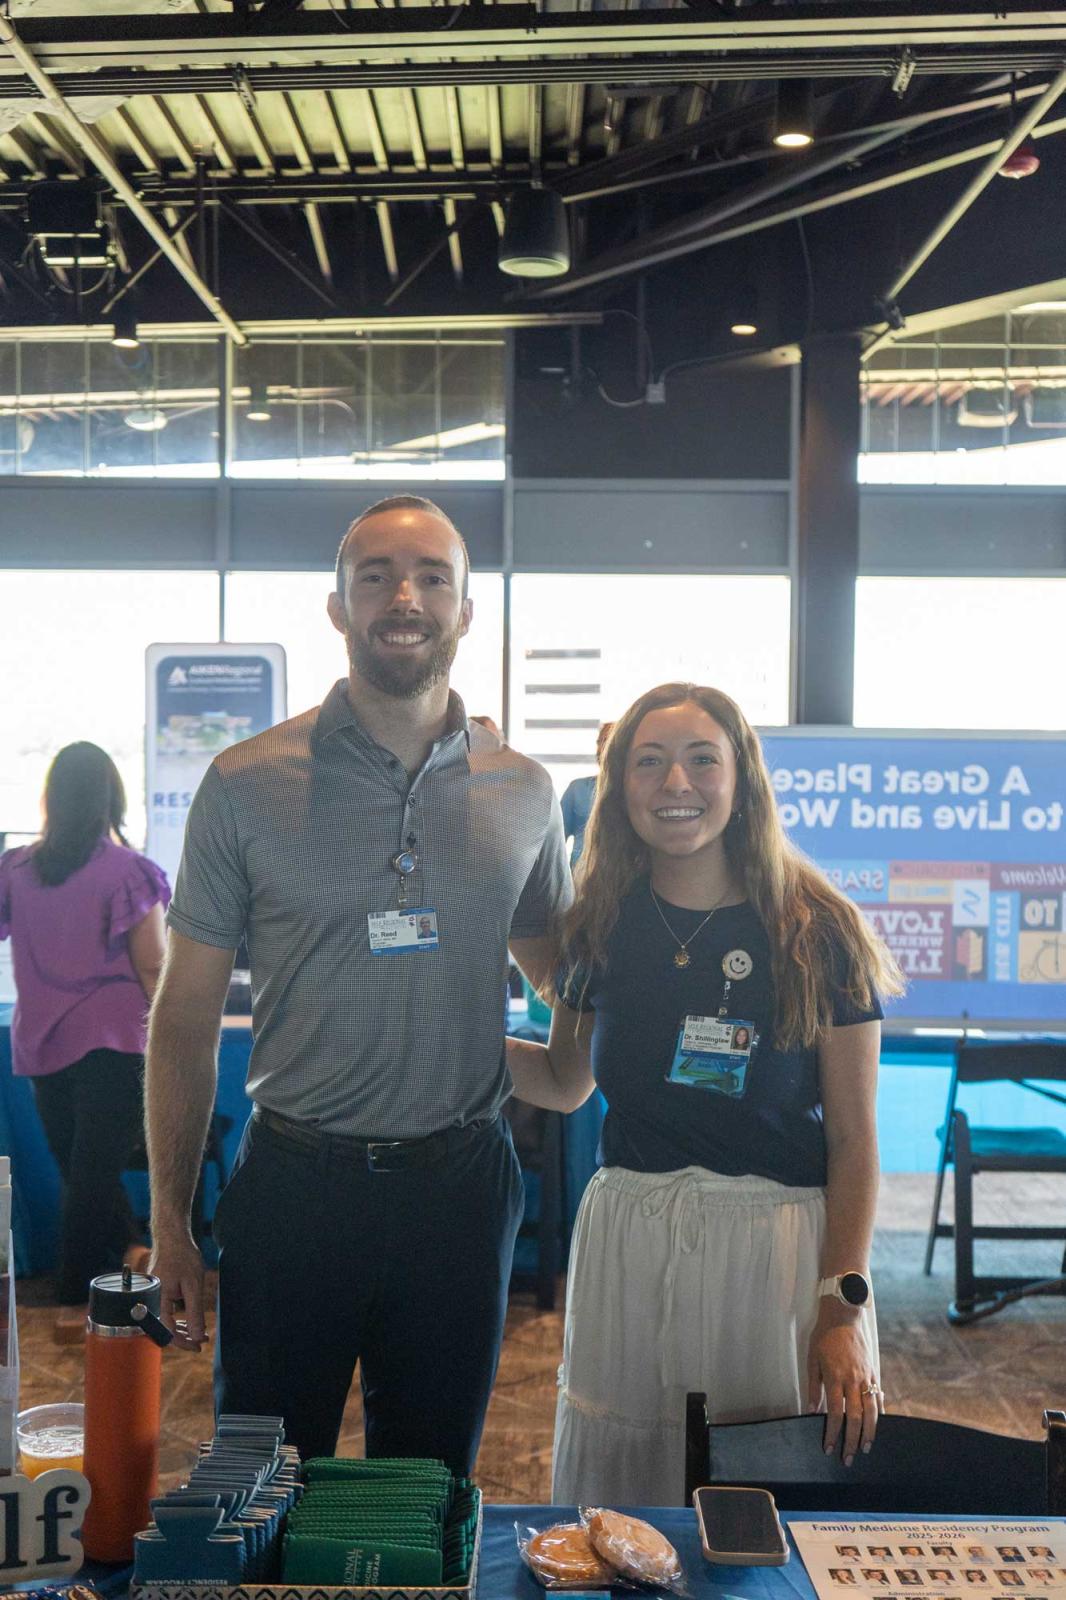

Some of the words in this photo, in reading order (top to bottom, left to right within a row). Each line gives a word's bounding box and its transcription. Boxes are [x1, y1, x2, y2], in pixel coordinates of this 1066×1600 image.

[153, 791, 193, 807] RES
[0, 1485, 80, 1570] lf
[812, 1523, 857, 1533] Family
[859, 1524, 921, 1533] Medicine
[923, 1525, 989, 1534] Residency
[991, 1524, 1051, 1534] Program
[906, 1532, 966, 1540] 2025-2026
[343, 1548, 356, 1584] IONAL
[372, 1553, 382, 1584] OGRAM
